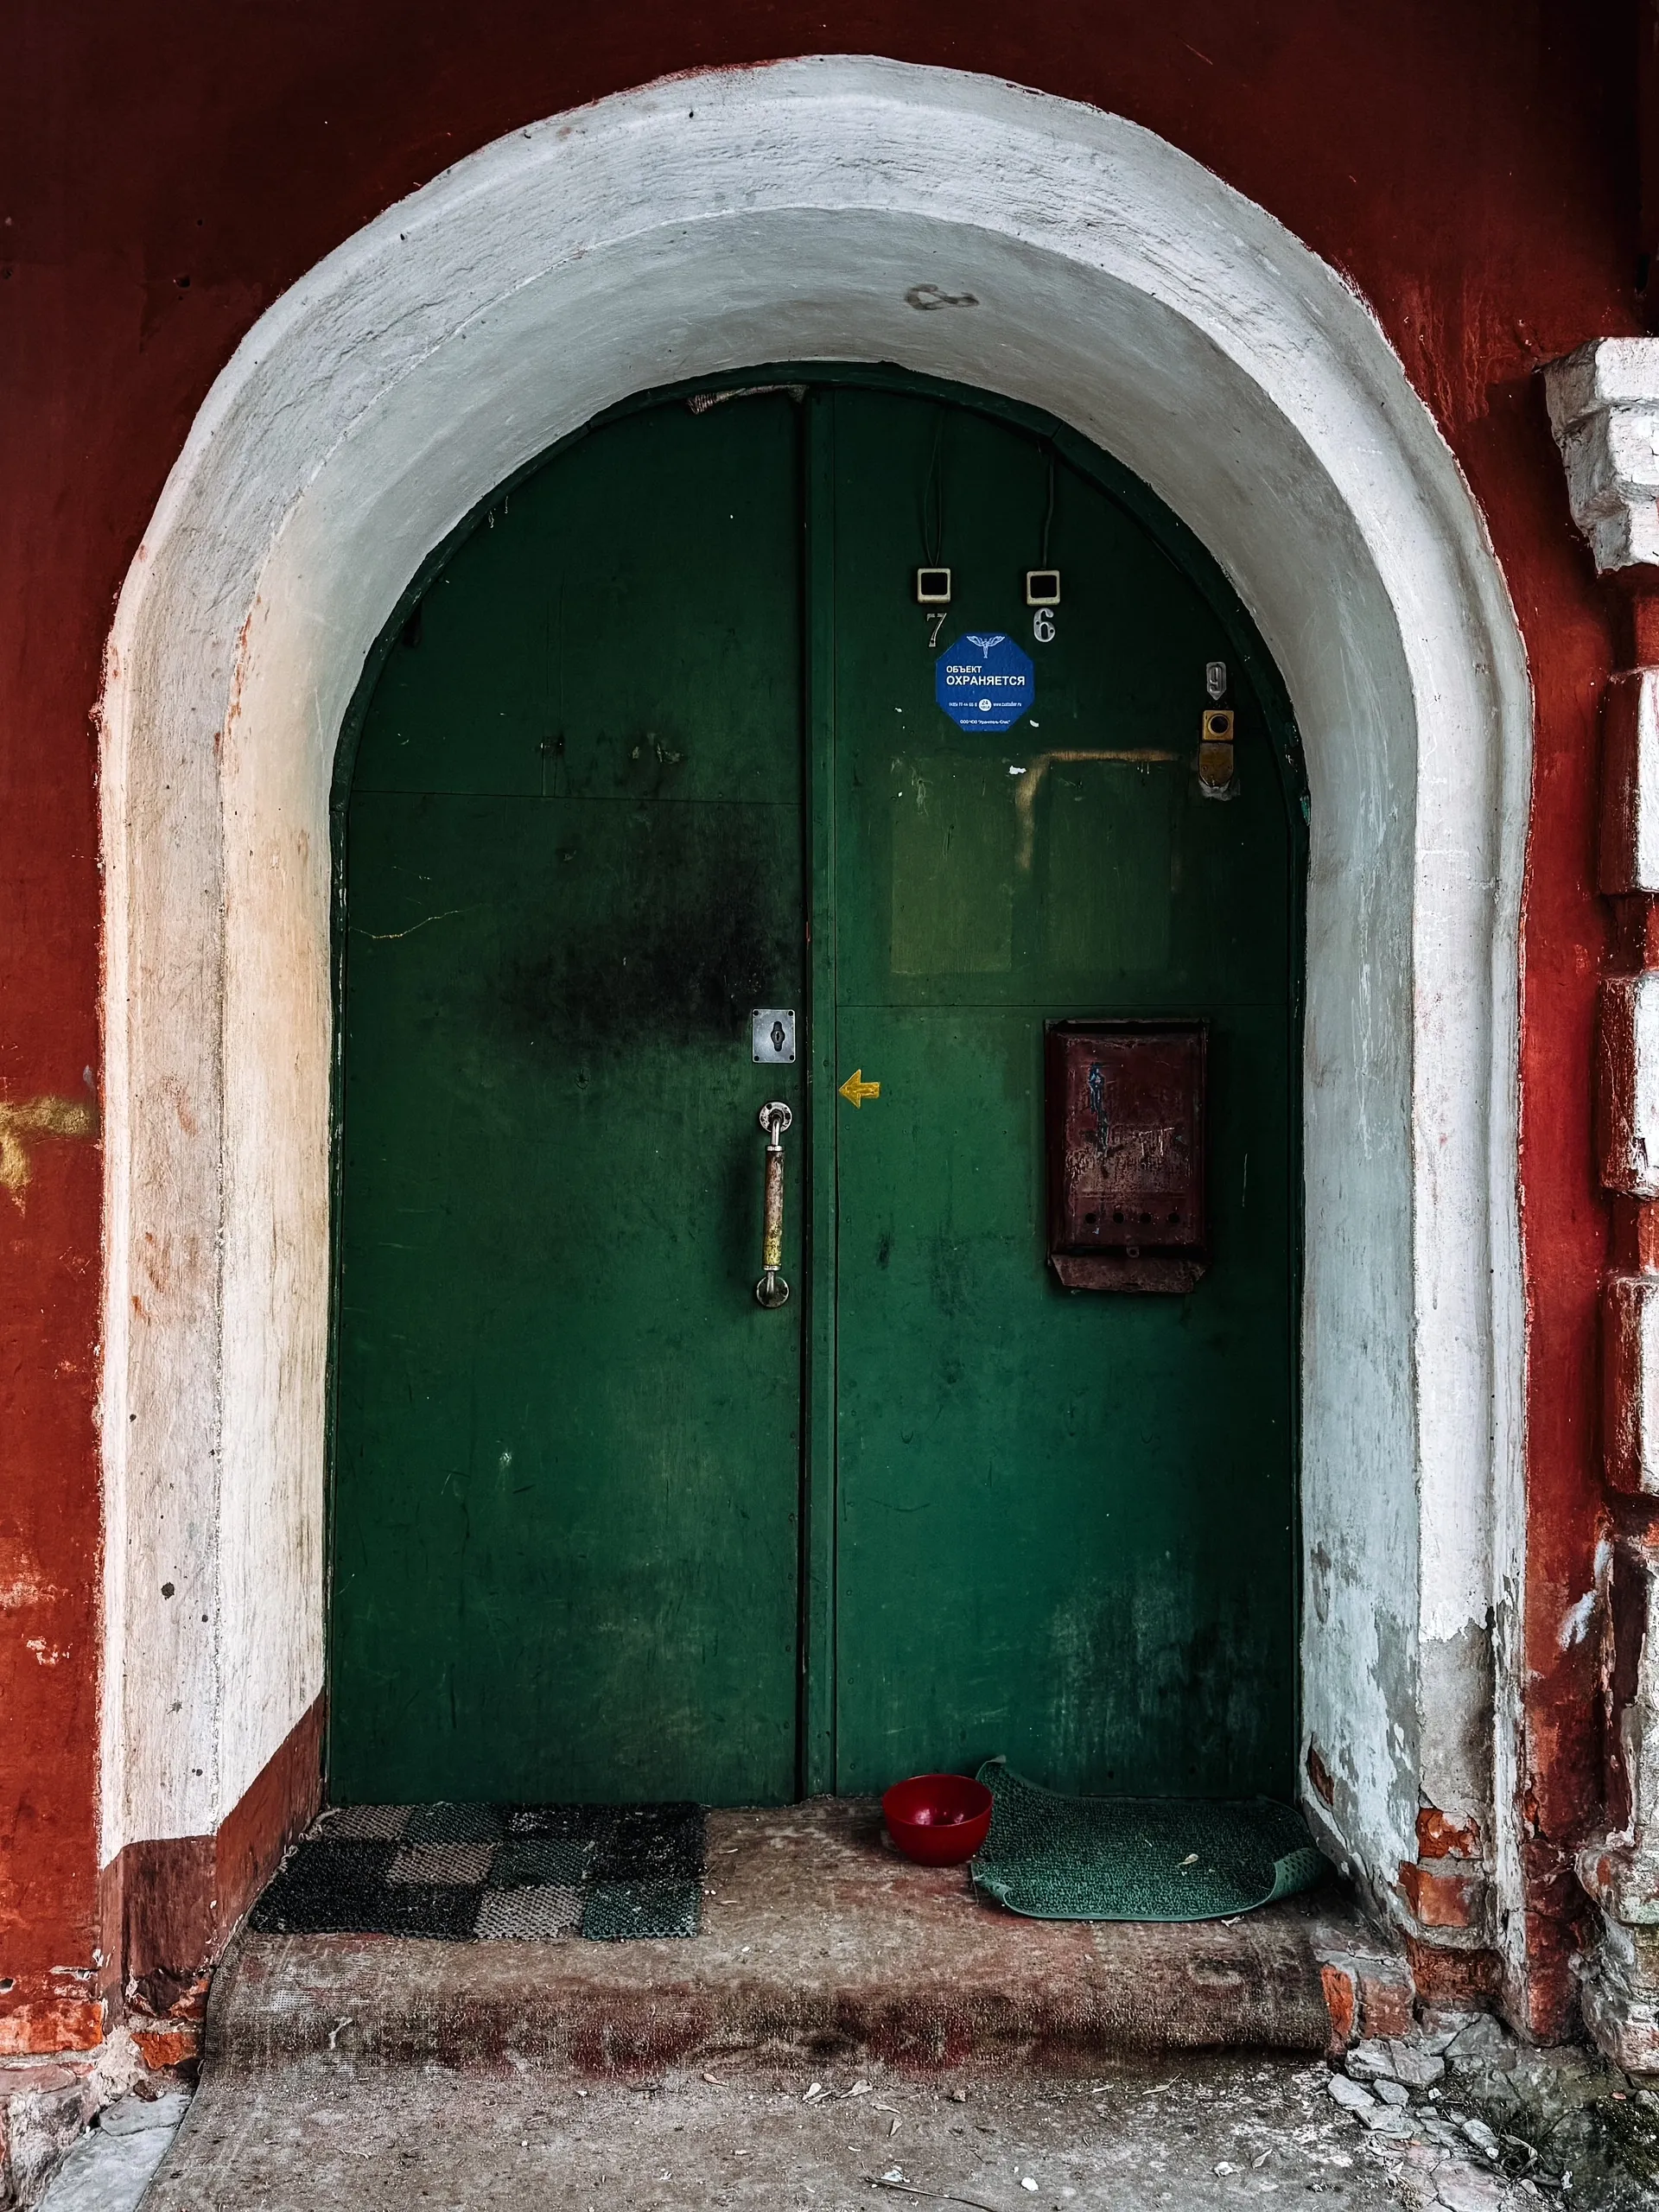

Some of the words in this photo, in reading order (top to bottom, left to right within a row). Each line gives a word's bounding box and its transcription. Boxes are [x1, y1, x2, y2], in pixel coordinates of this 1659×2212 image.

[926, 612, 947, 648] 7
[1033, 607, 1056, 643] 6
[946, 676, 1026, 686] ОХРАНЯЕТСЯ
[1209, 664, 1223, 694] 9
